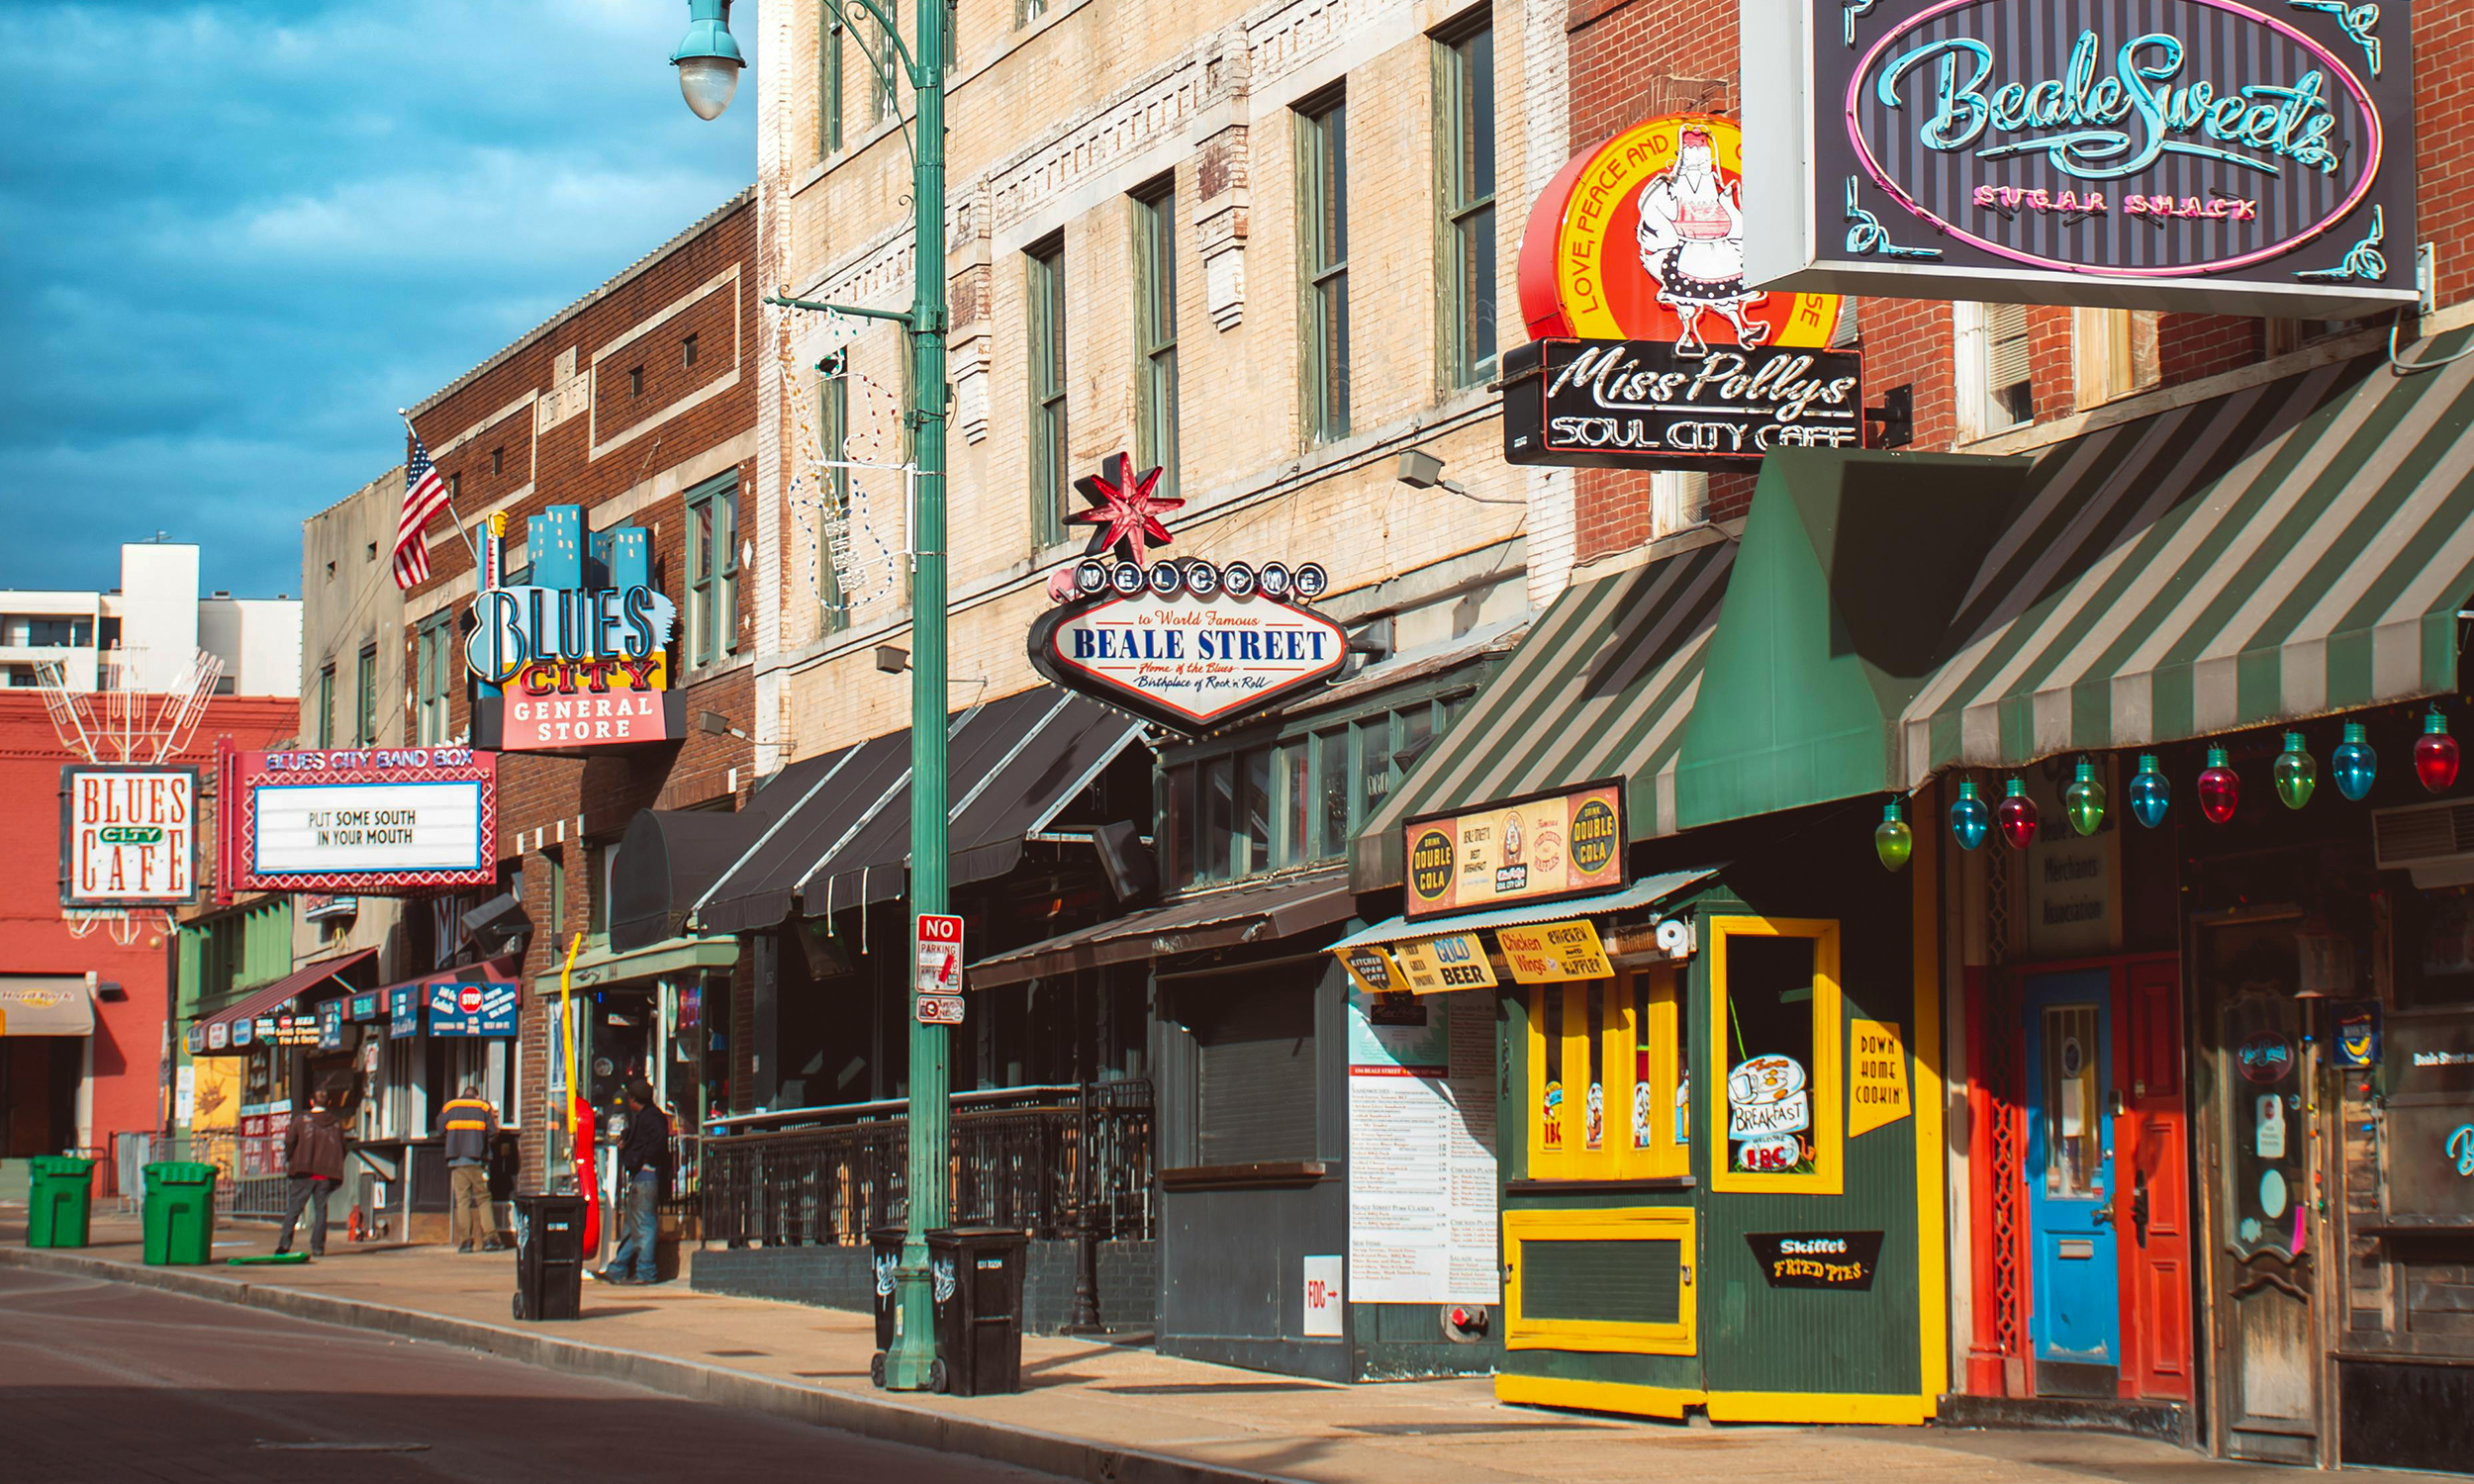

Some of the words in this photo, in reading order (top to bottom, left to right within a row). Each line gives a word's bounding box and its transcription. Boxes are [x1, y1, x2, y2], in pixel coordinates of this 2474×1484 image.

[1627, 135, 1668, 168] AND
[1577, 160, 1626, 233] PEACE
[1972, 184, 2107, 212] SUGAR
[2124, 193, 2256, 220] SHACK
[1572, 242, 1599, 314] LOVE,
[1547, 346, 1688, 402] Miss
[1688, 352, 1856, 422] Pollys
[1551, 417, 1666, 450] SOUL
[1666, 421, 1749, 452] CITY
[1081, 565, 1320, 594] WELCOME
[1138, 614, 1151, 625] to
[1154, 609, 1201, 626] World
[1207, 610, 1260, 627] Famous
[489, 586, 657, 684] BLUES
[1073, 628, 1184, 660] BEALE
[1198, 629, 1328, 661] STREET
[520, 660, 661, 696] CITY
[1138, 662, 1173, 674] Home
[1176, 662, 1184, 677] of
[1187, 662, 1203, 674] the
[1205, 663, 1237, 674] Blues
[1135, 675, 1190, 691] Birthplace
[1193, 677, 1203, 692] of
[514, 696, 653, 722] GENERAL
[537, 719, 630, 742] STORE
[266, 752, 326, 772] BLUES
[330, 751, 371, 770] CITY
[375, 750, 428, 769] BAND
[433, 748, 474, 768] BOX
[82, 778, 186, 824] BLUES
[309, 812, 332, 828] PUT
[336, 811, 370, 827] SOME
[374, 809, 416, 826] SOUTH
[1574, 815, 1613, 842] DOUBLE
[99, 826, 163, 845] CITY
[318, 831, 329, 846] IN
[333, 830, 363, 845] YOUR
[367, 829, 413, 844] MOUTH
[82, 829, 186, 892] CAFE
[1415, 847, 1451, 871] DOUBLE
[1579, 841, 1606, 864] COLA
[1419, 871, 1445, 891] COLA
[2043, 898, 2101, 926] Association
[926, 919, 954, 938] NO
[921, 944, 956, 957] PARKING
[1434, 937, 1470, 963] COLD
[1501, 933, 1543, 952] Chicken
[1351, 957, 1382, 968] KITCHEN
[1360, 967, 1382, 975] OPEN
[1514, 955, 1547, 976] Wings
[1440, 965, 1486, 986] BEER
[462, 992, 481, 1005] STOP
[1861, 1035, 1894, 1055] DOWN
[1861, 1061, 1896, 1080] HOME
[2414, 1052, 2438, 1067] Beale
[2438, 1052, 2465, 1066] Street
[1735, 1101, 1802, 1132] BREAKFAST
[1747, 1146, 1787, 1168] IBC
[1779, 1238, 1848, 1255] Skillet
[1774, 1257, 1824, 1278] FRIED
[1825, 1260, 1862, 1283] PIES
[1308, 1280, 1326, 1309] FDC
